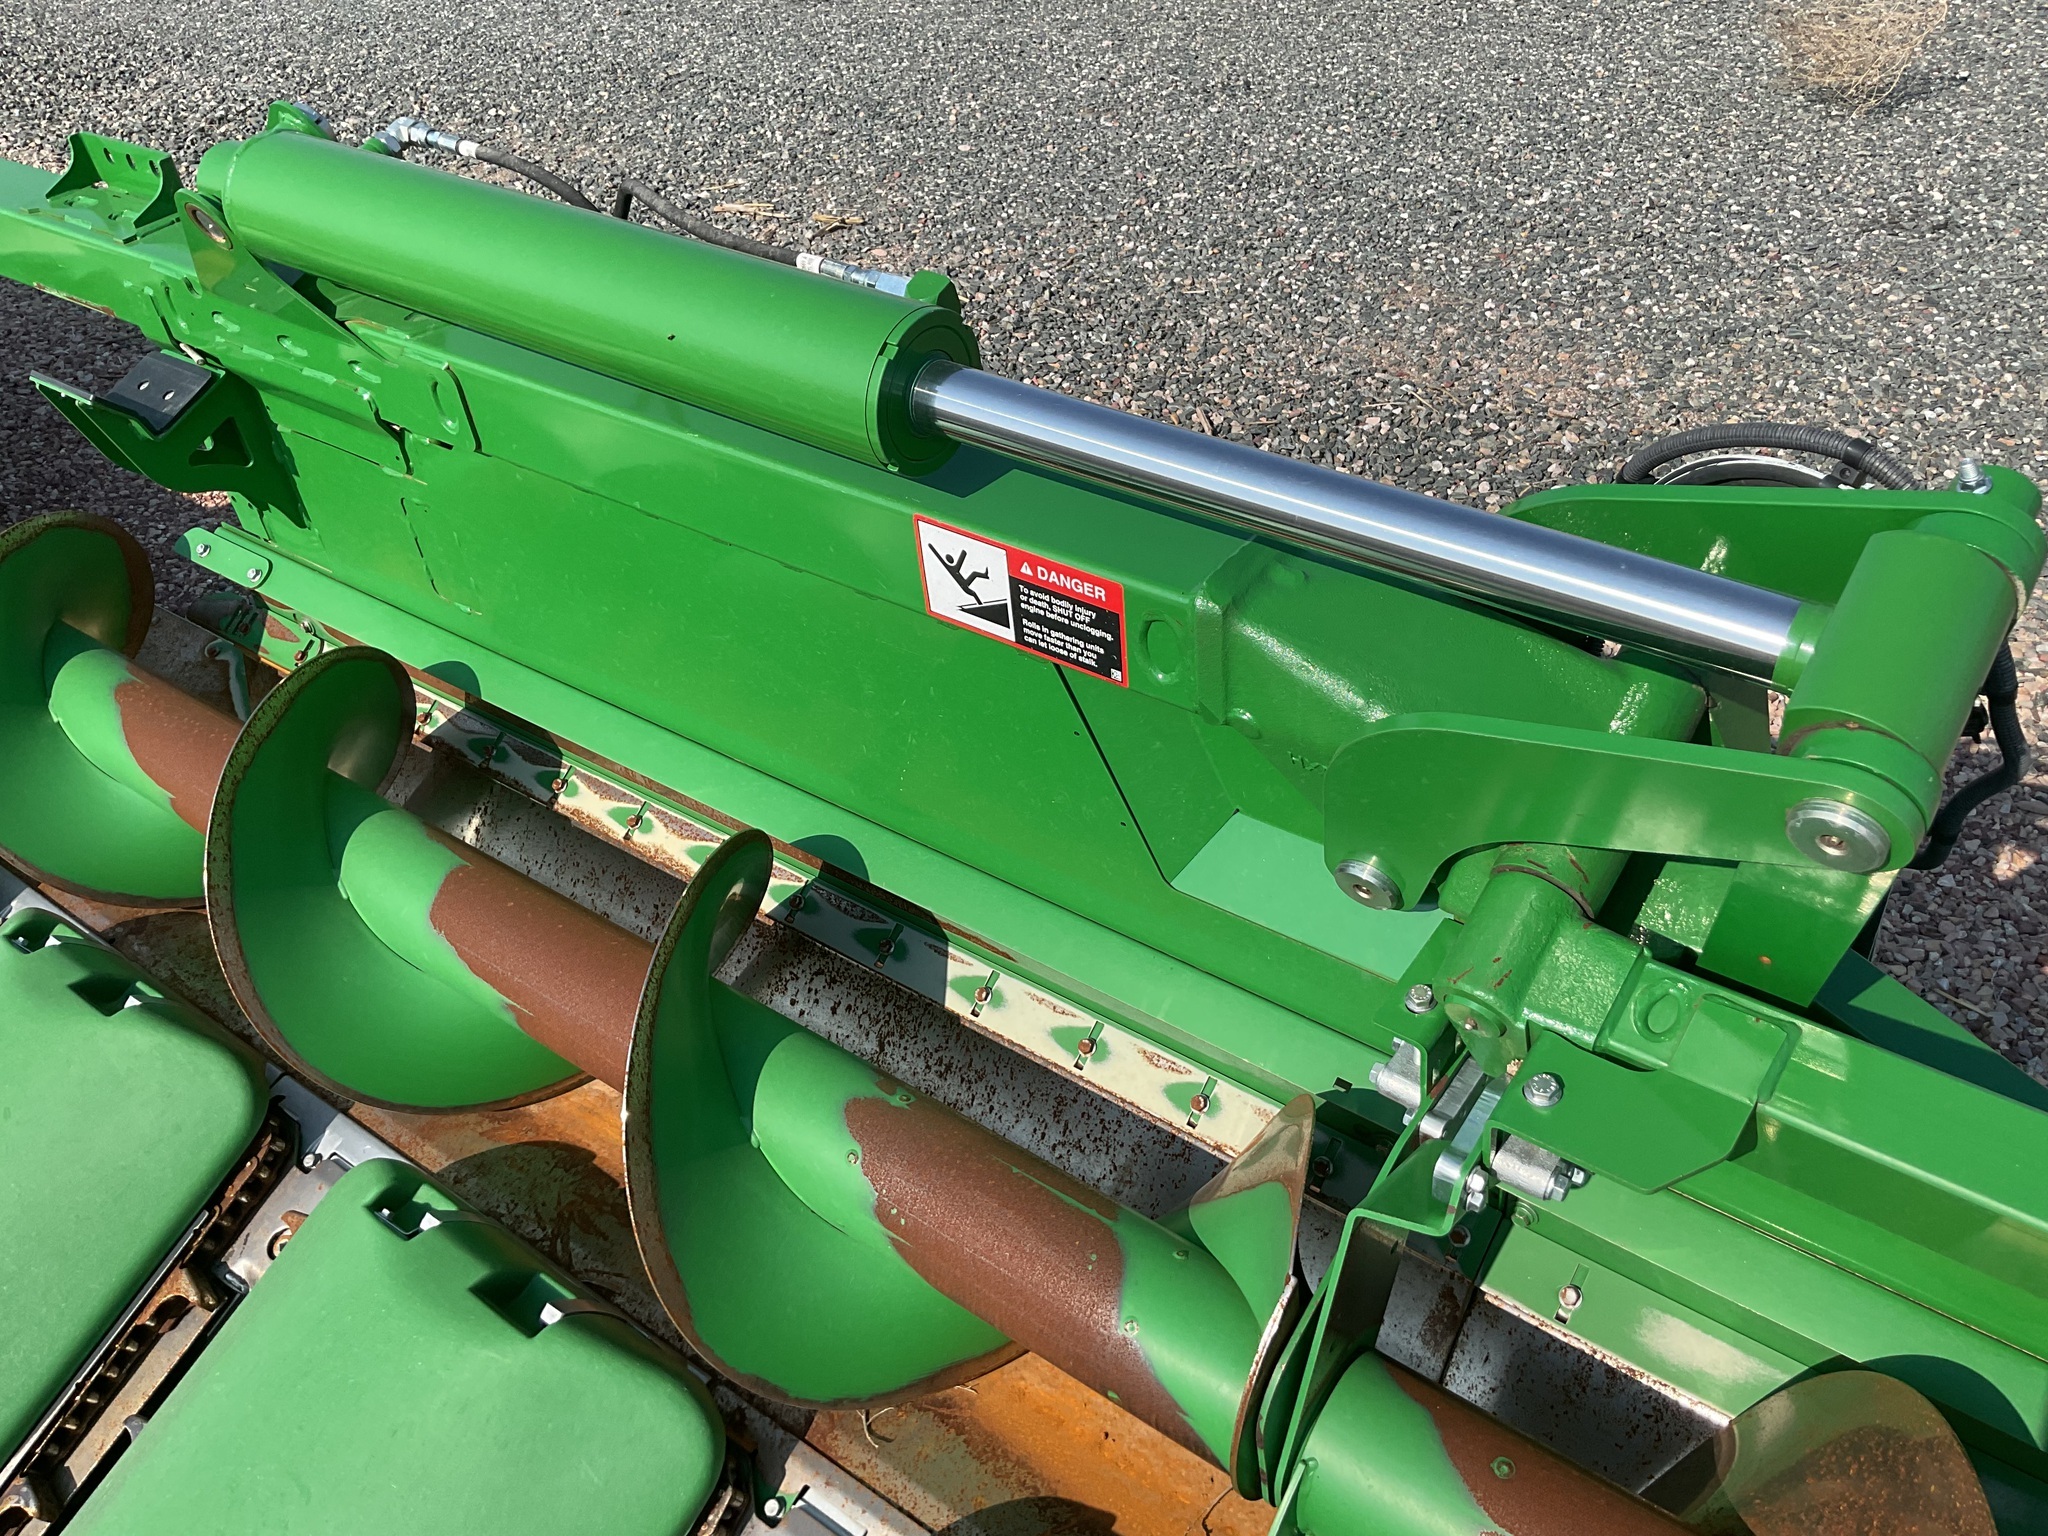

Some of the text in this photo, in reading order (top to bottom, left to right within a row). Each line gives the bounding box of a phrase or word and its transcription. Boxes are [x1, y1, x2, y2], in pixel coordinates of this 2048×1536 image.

[1037, 566, 1106, 601] DANGER
[1018, 584, 1096, 619] To avoid bodily injury
[1052, 605, 1073, 618] SHUT
[1074, 613, 1090, 624] OFF
[1020, 603, 1114, 642] engine before unclogging.
[1022, 618, 1105, 654] Rolls in gathering units
[1023, 628, 1098, 660] move faster than you
[1024, 636, 1038, 644] can
[1038, 639, 1048, 648] let
[1048, 643, 1068, 656] loose
[1078, 656, 1098, 668] stalk.
